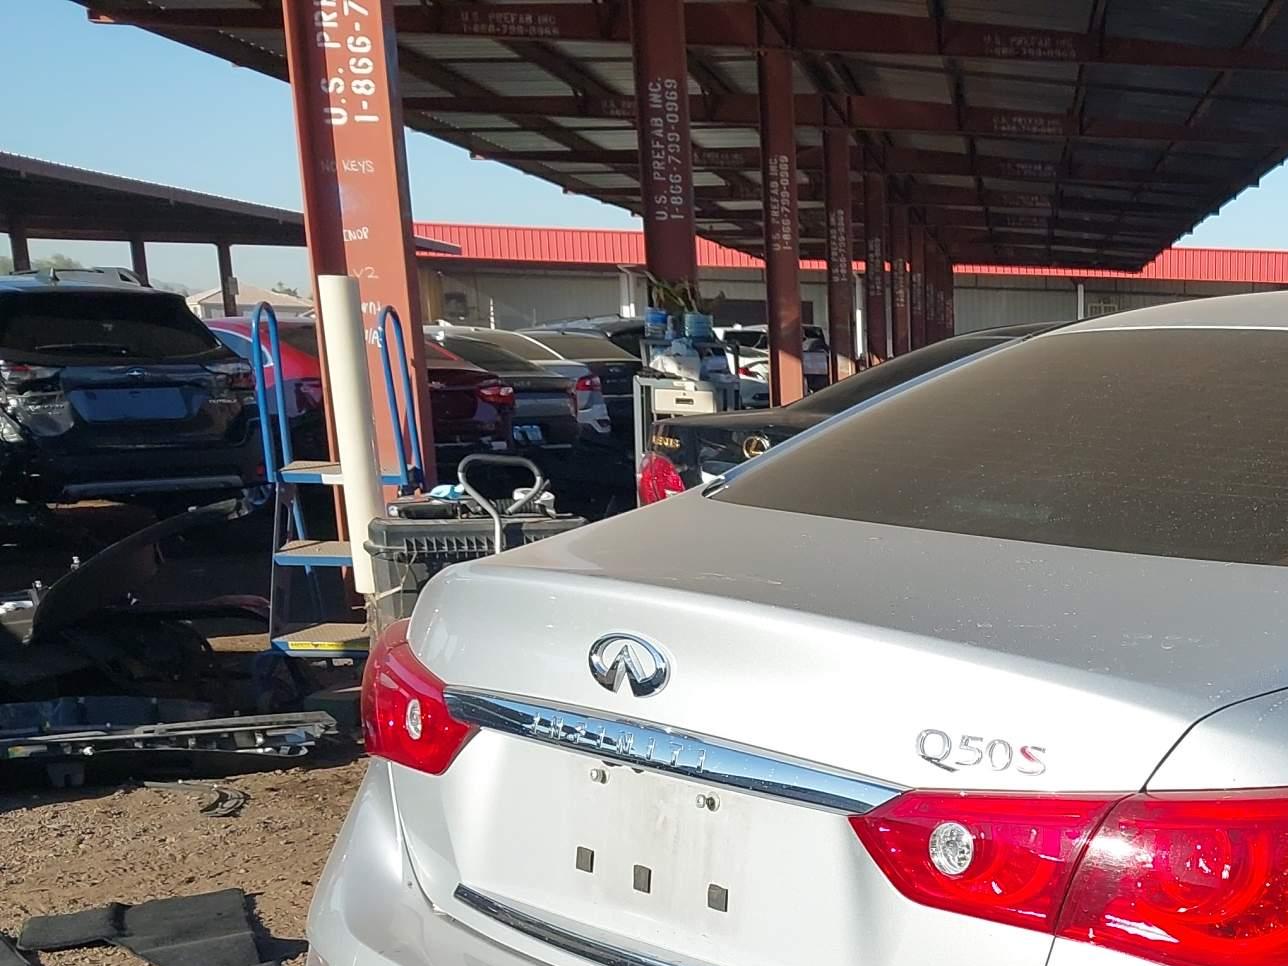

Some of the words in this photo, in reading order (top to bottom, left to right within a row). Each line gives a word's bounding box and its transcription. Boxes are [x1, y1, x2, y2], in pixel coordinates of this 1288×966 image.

[320, 67, 348, 125] U.S.
[647, 77, 664, 108] INC.
[342, 159, 375, 174] KEYS
[650, 117, 667, 181] PREFAB
[664, 78, 685, 219] 1-866-799-0969
[654, 189, 669, 221] U.S.
[915, 728, 1047, 776] Q50S
